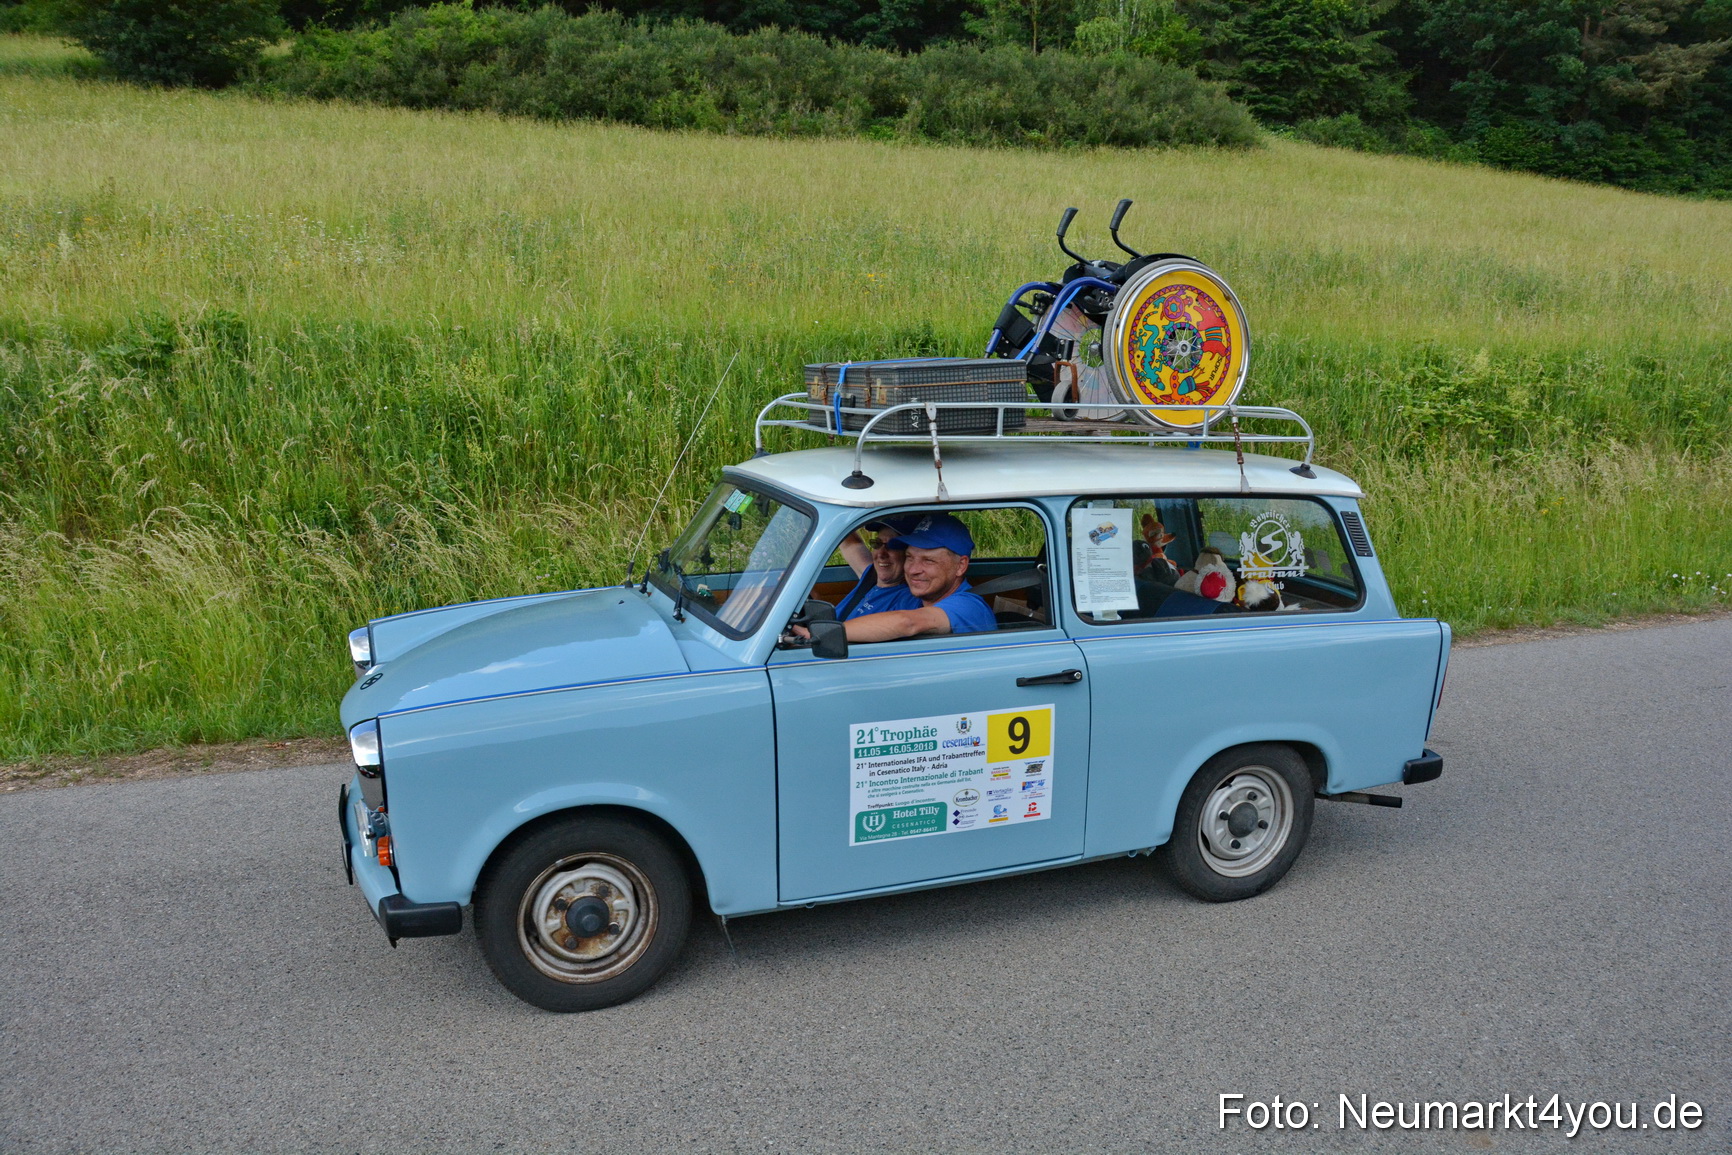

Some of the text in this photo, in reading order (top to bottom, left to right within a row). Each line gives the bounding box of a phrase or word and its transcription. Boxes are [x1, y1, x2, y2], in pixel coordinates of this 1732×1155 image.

[1209, 356, 1222, 380] SOPUR
[880, 726, 938, 742] Trophäe
[1008, 716, 1030, 754] 9
[858, 748, 880, 758] 11.05
[890, 742, 934, 754] 16.05.2018
[942, 736, 981, 749] cesenatico
[868, 759, 916, 768] Internationales
[942, 750, 986, 760] Trabanttreffen
[869, 779, 898, 788] Incontro
[900, 772, 948, 784] Internazionale
[958, 768, 984, 776] Trabant
[877, 767, 910, 776] Cesenatico
[956, 794, 978, 803] Krombacher
[892, 806, 940, 819] Hotel Tilly
[892, 819, 936, 829] CESENATICO
